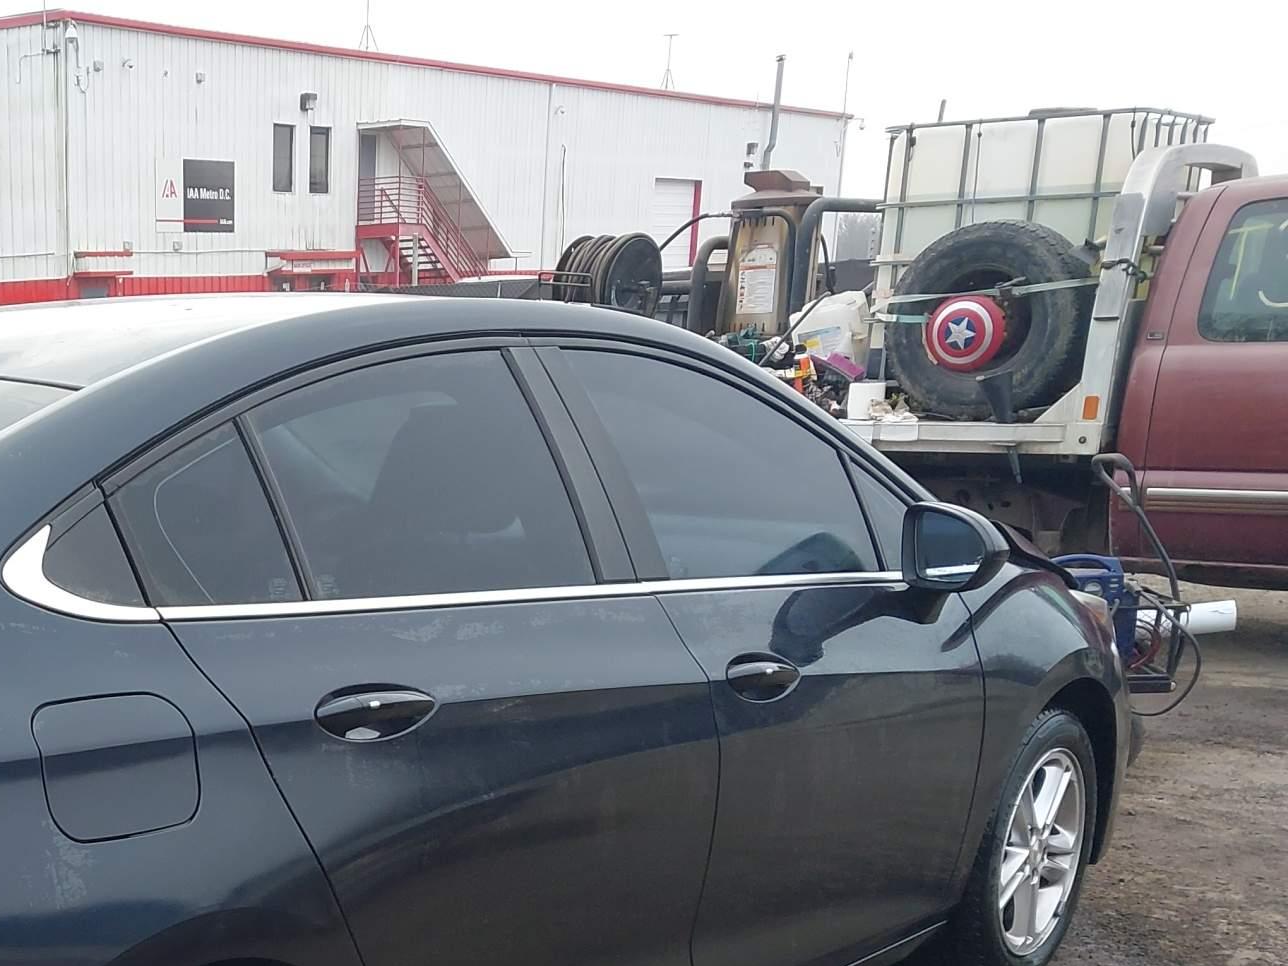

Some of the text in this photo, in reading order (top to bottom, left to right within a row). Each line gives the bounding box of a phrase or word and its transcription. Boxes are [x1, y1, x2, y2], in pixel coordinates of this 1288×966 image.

[186, 187, 231, 200] IAA Metro D.C.
